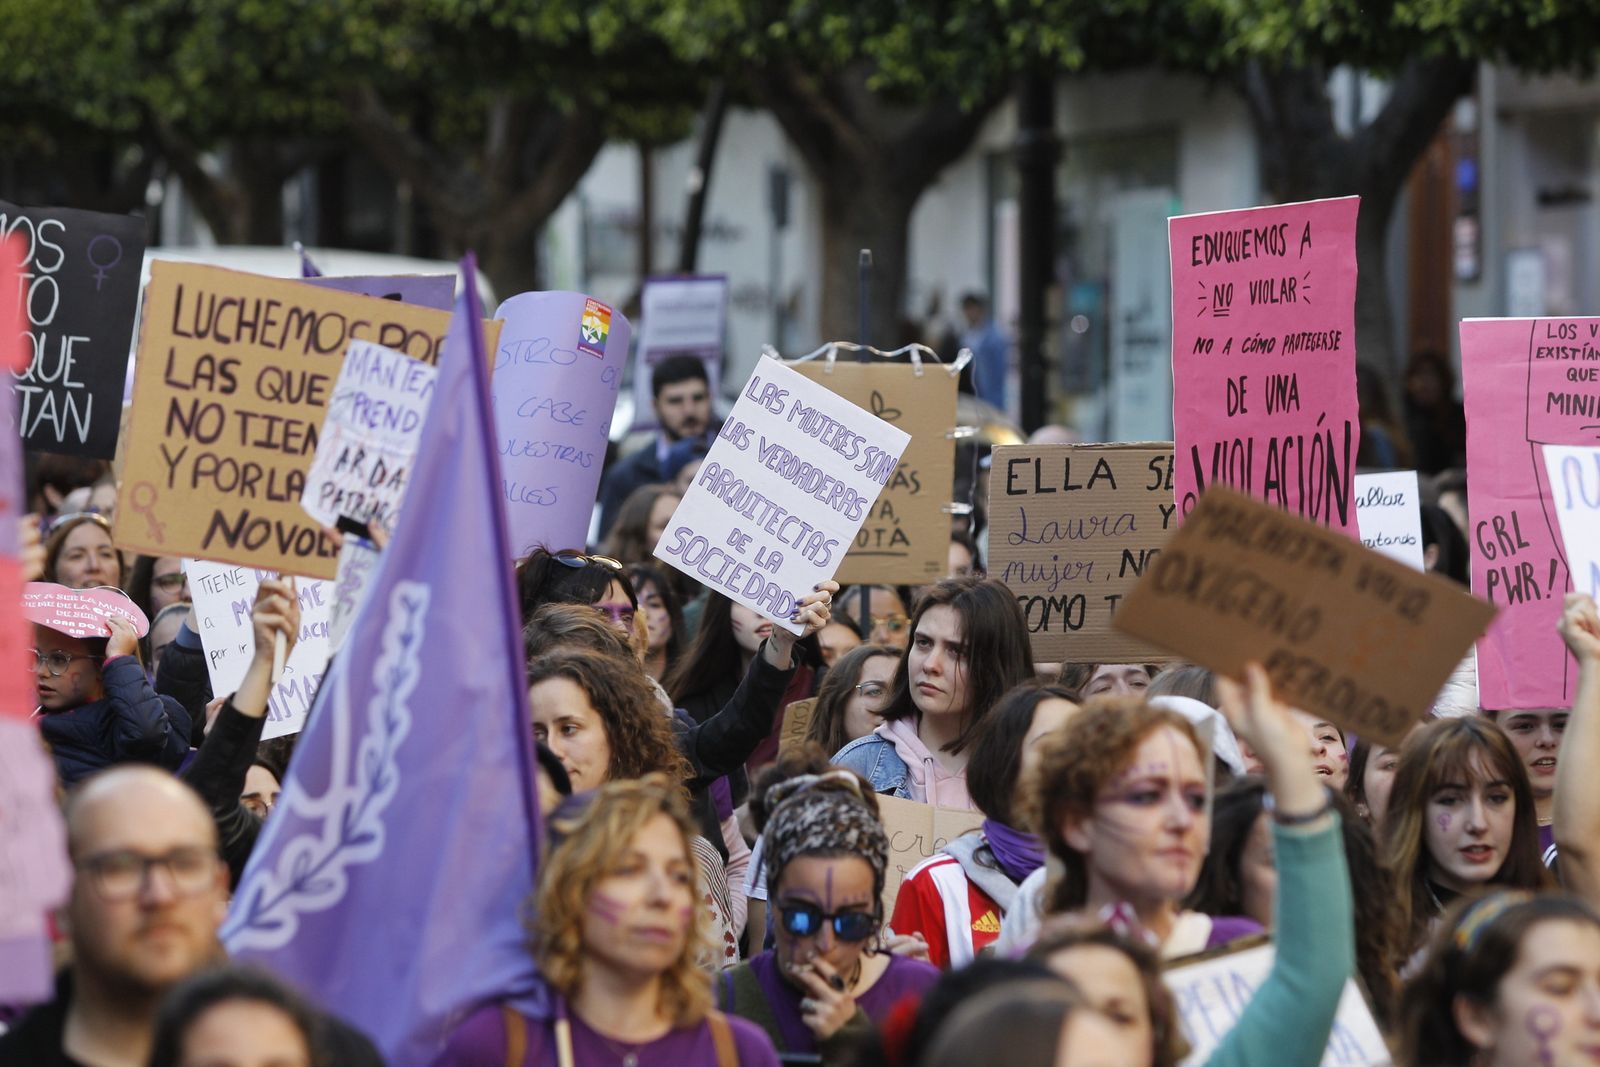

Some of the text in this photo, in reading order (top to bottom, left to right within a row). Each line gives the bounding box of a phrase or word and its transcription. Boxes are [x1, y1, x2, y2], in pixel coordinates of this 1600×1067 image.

[1191, 220, 1312, 267] EDUQUEMOS A
[1213, 277, 1297, 309] NO VIOLAR
[1192, 329, 1342, 356] NO A CÓMO PROTEGERSE
[1547, 323, 1600, 340] LOS V
[11, 331, 90, 387] QUE
[165, 348, 330, 407] LAS QUE
[1567, 367, 1599, 382] QUE
[14, 384, 92, 443] TAN
[517, 396, 587, 425] CABE
[1227, 373, 1300, 417] DE UNA
[165, 397, 225, 444] NO
[745, 376, 897, 485] LAS MUJERES SON
[160, 444, 189, 489] Y
[192, 453, 263, 498] POR
[719, 415, 868, 521] LAS VERDADERAS
[887, 463, 920, 495] ÁS
[1006, 457, 1117, 495] ELLA
[202, 509, 272, 551] NO
[698, 462, 839, 567] ARQUITECTAS
[1008, 506, 1137, 545] Laura
[1159, 503, 1175, 529] Y
[1476, 510, 1530, 560] GRL
[727, 528, 784, 573] DE LA
[1360, 531, 1416, 548] ritando
[198, 566, 246, 595] TIENE
[666, 526, 797, 619] SOCIEDAD
[1487, 558, 1558, 606] PWR!
[210, 647, 227, 670] por
